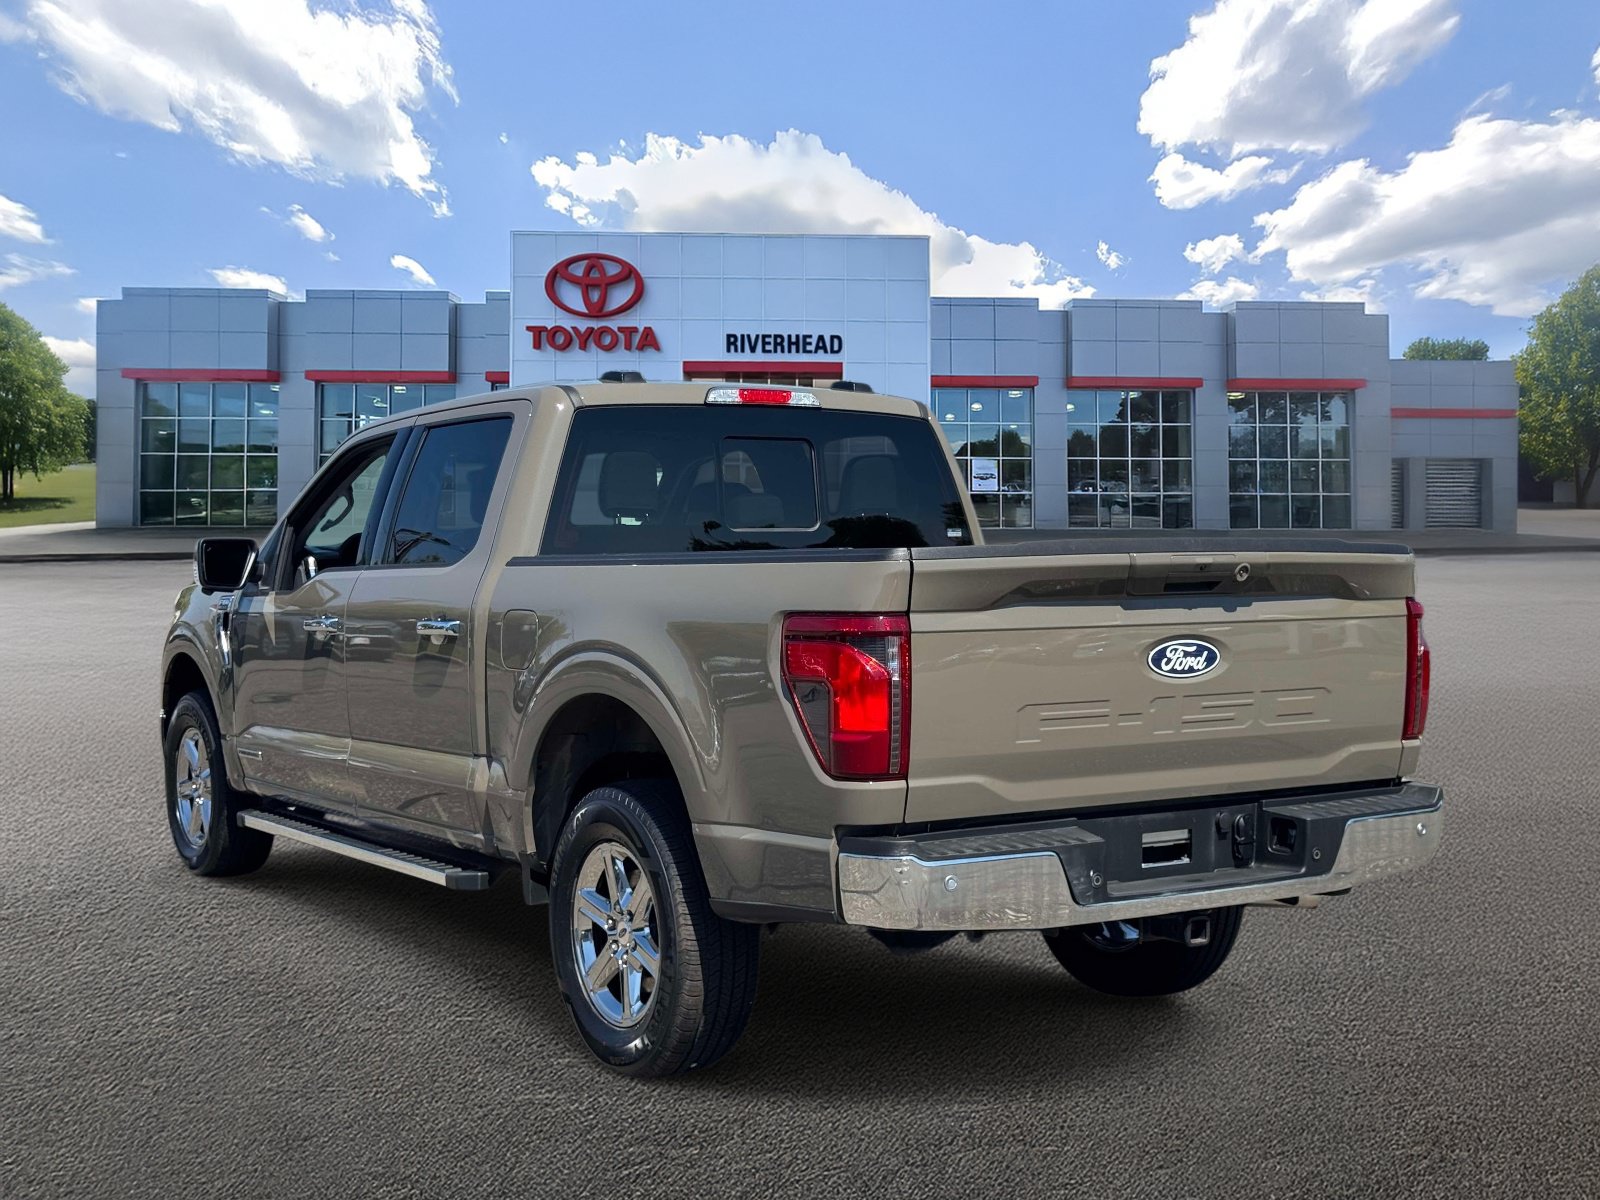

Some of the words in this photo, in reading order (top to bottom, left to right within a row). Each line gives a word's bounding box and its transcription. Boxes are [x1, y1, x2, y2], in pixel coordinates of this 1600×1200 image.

[526, 325, 661, 352] TOYOTA
[725, 333, 843, 354] RIVERHEAD
[1160, 644, 1209, 671] Ford
[1015, 686, 1332, 744] F-150
